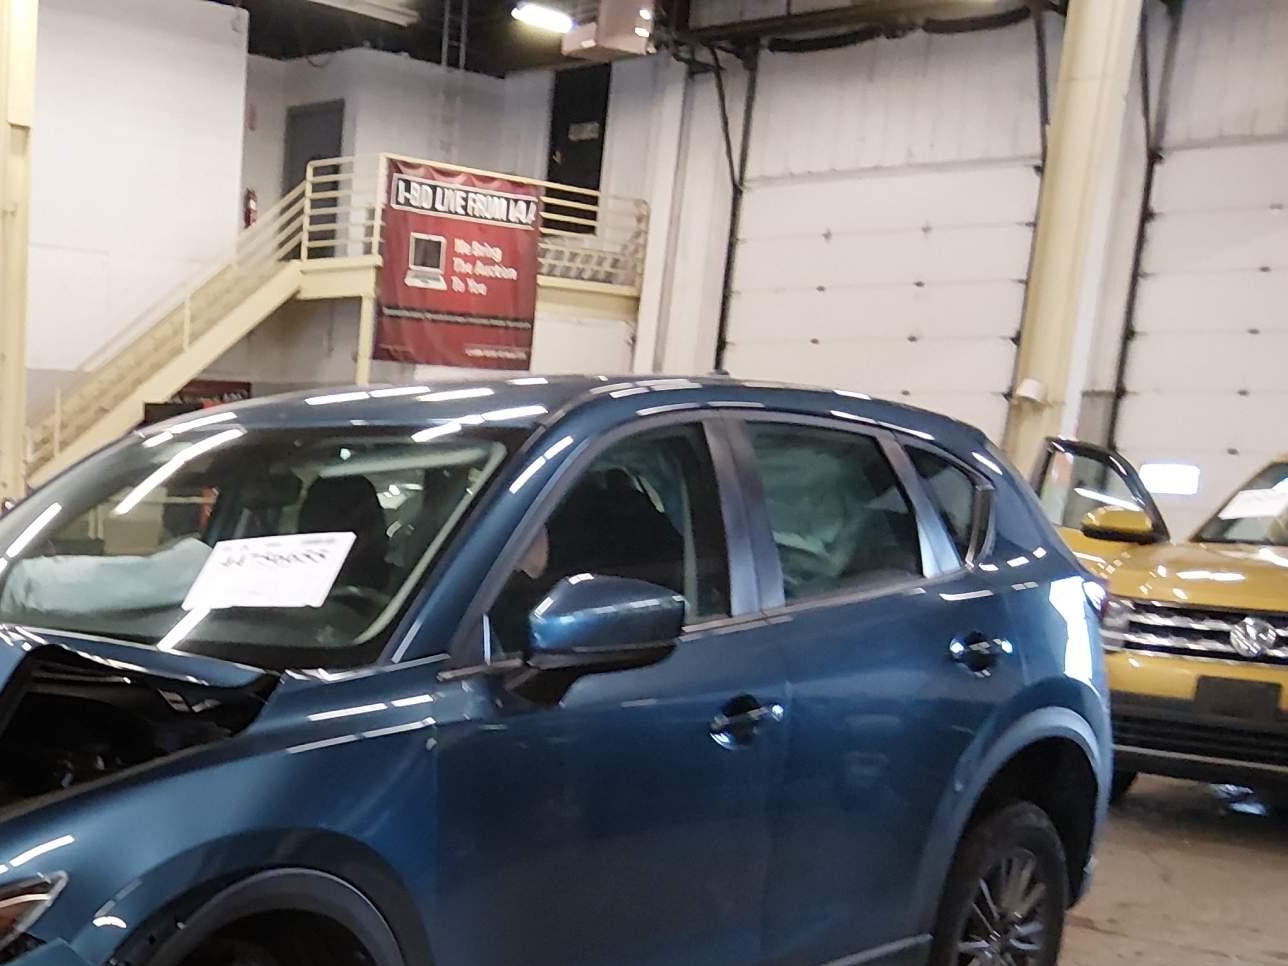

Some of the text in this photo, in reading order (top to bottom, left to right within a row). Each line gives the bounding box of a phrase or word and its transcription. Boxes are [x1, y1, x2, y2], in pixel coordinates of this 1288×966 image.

[434, 186, 466, 215] LIVE
[467, 192, 508, 221] FROM
[452, 257, 473, 275] The
[451, 276, 466, 293] To
